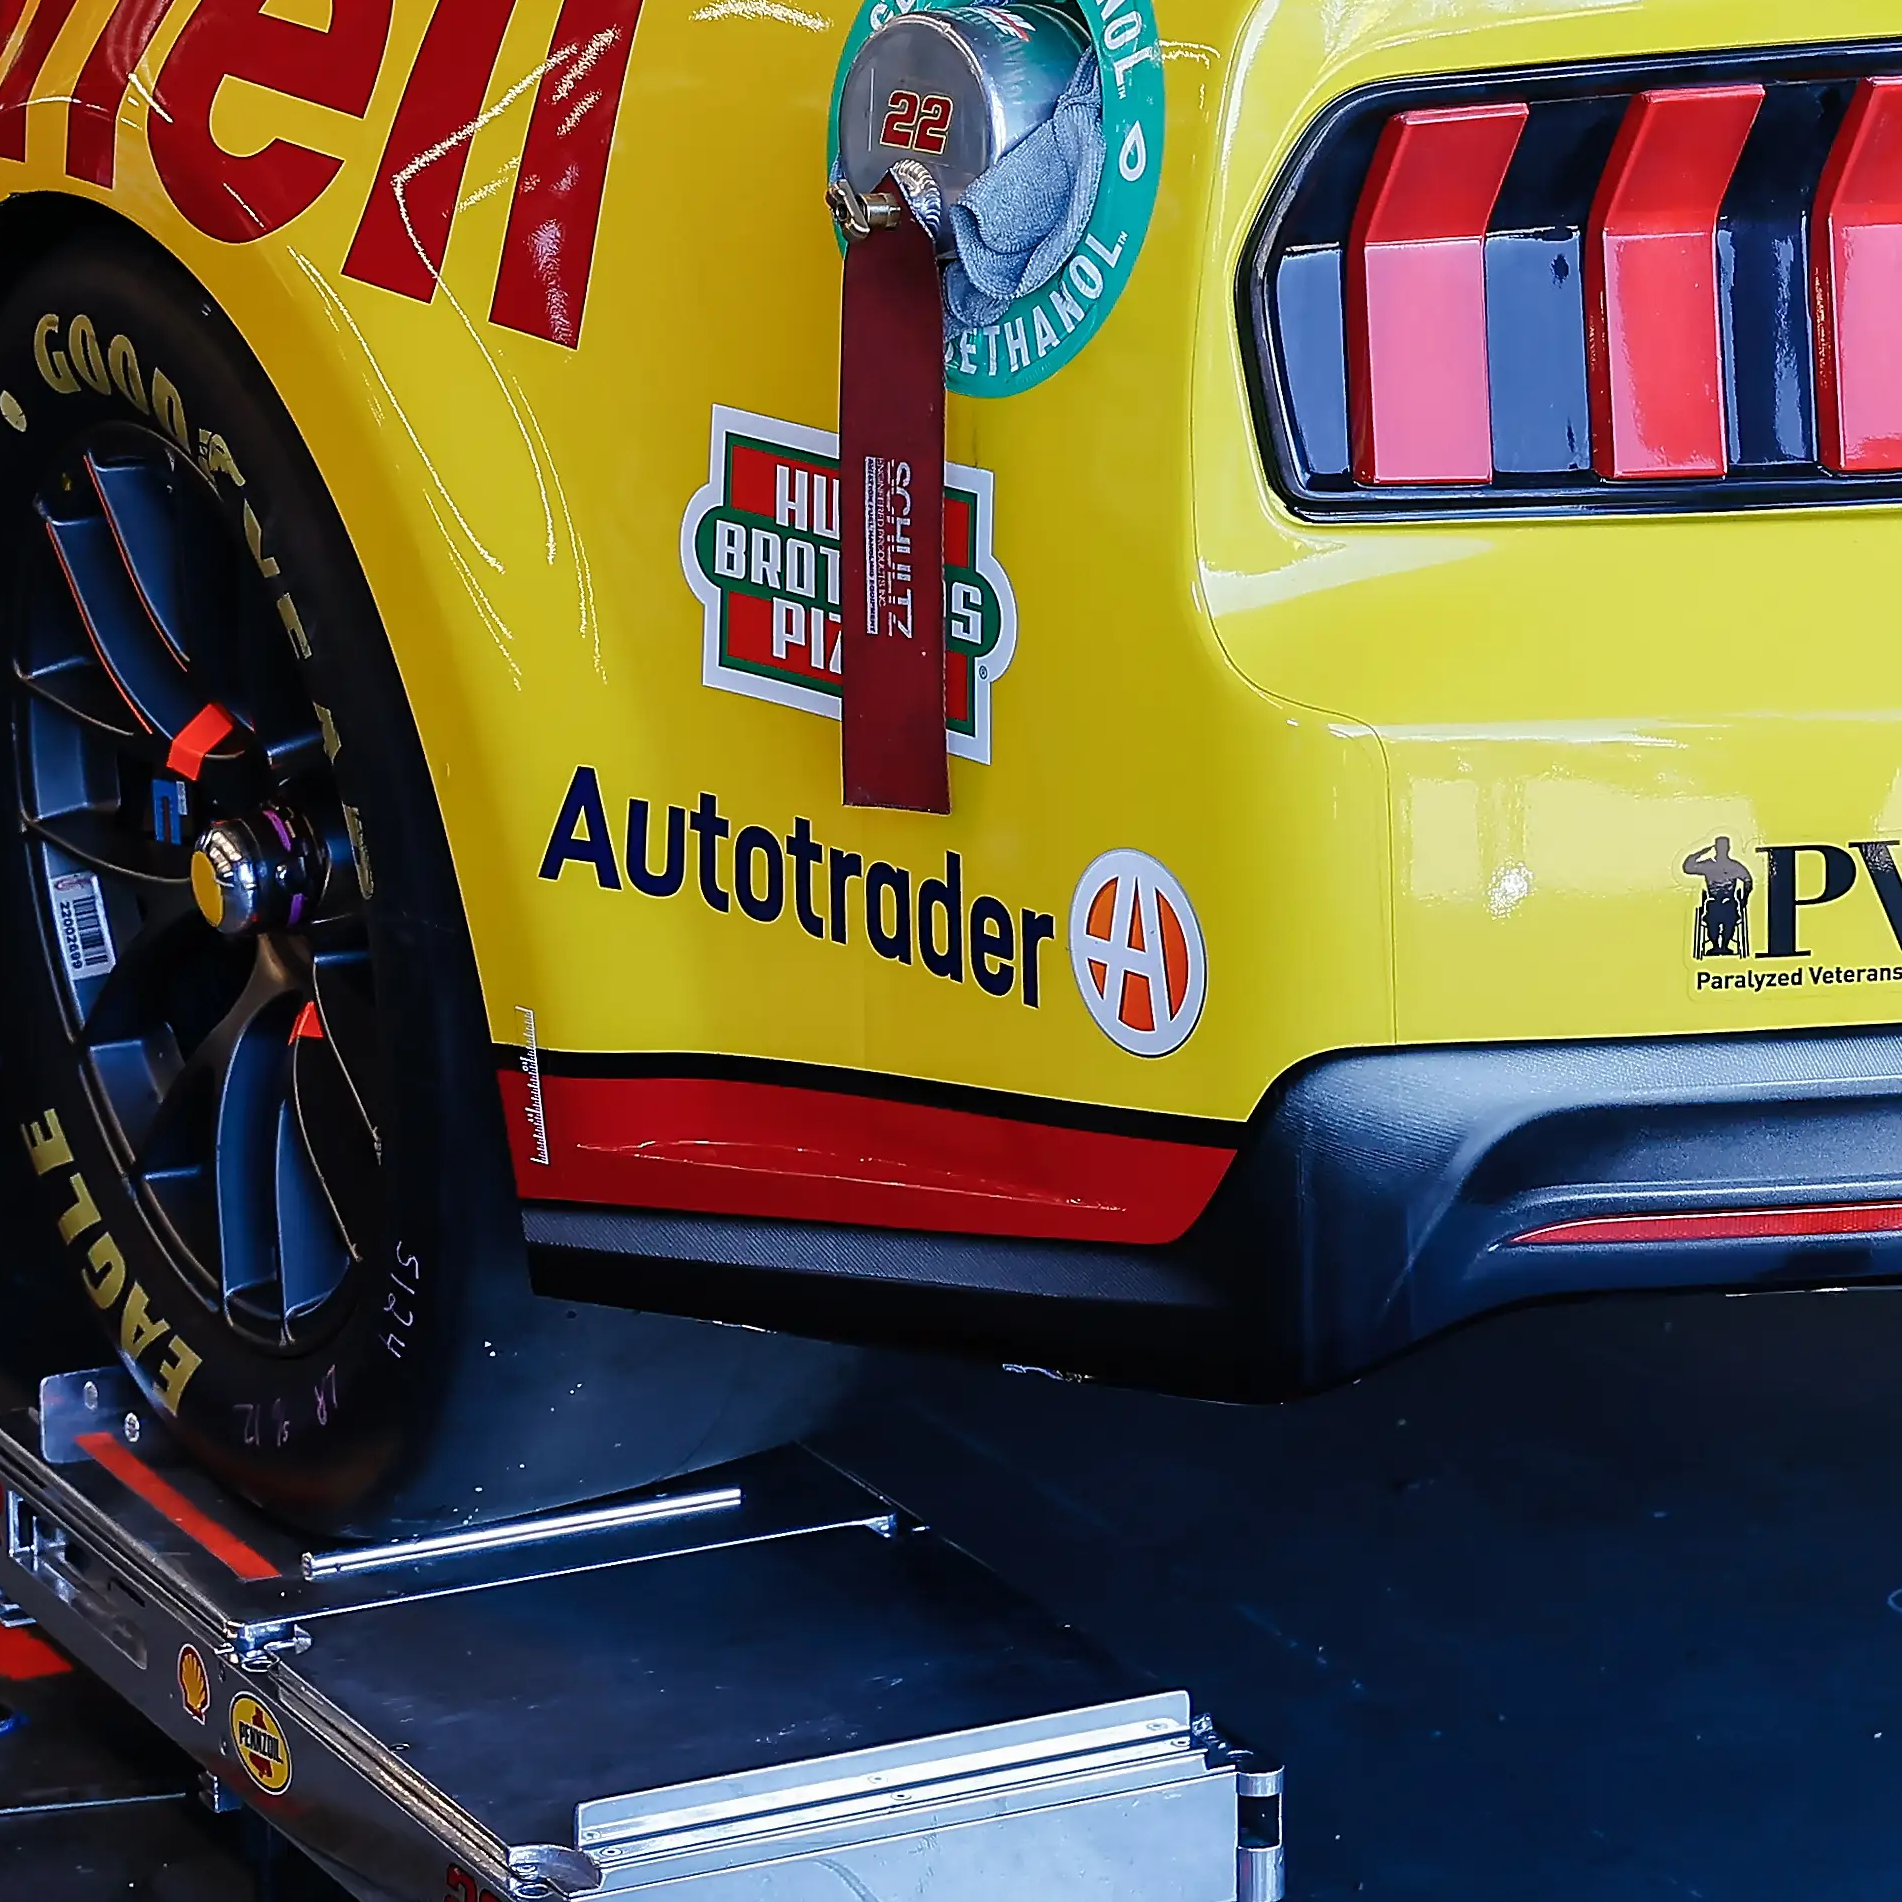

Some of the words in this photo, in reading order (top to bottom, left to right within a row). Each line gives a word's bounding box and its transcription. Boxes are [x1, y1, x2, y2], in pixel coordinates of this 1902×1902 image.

[879, 90, 954, 155] 22
[876, 528, 886, 587] PRODUCTS
[886, 460, 912, 639] SCHULTZ
[538, 765, 1055, 1009] Autotrader
[1696, 967, 1804, 994] Paralyzed
[22, 1108, 203, 1416] EAGLE
